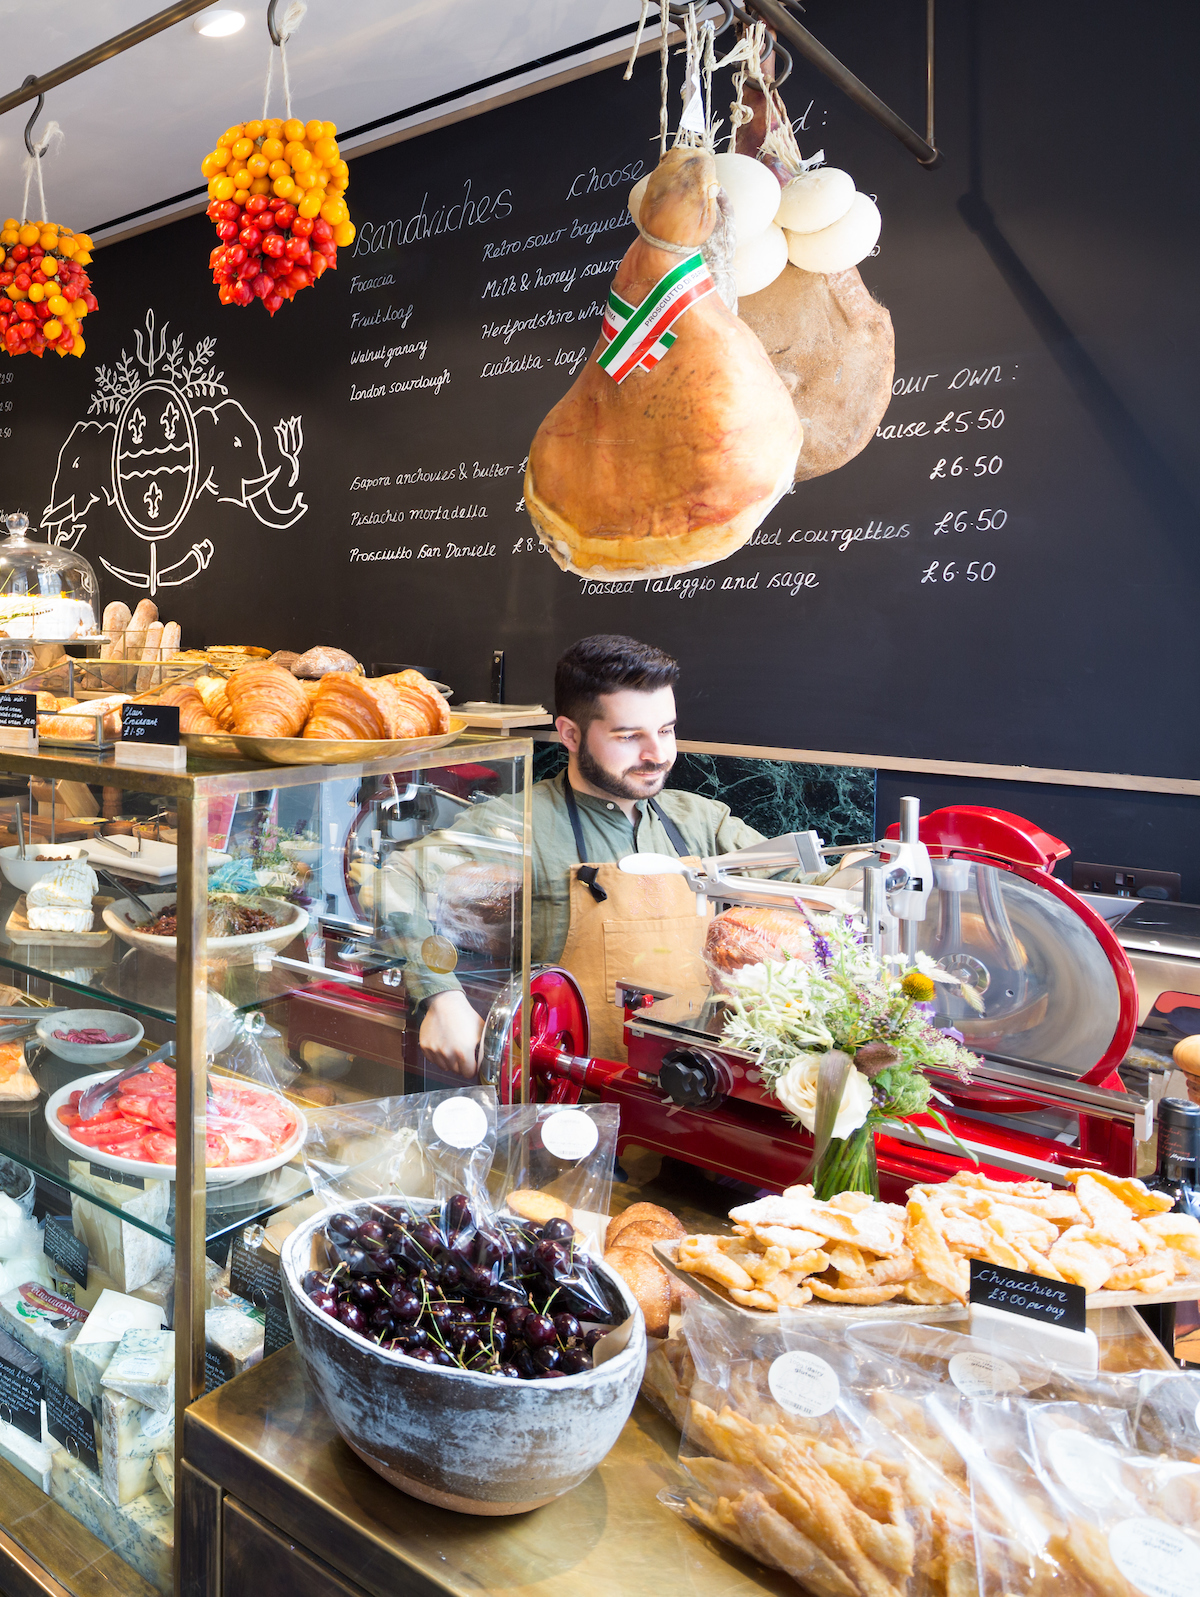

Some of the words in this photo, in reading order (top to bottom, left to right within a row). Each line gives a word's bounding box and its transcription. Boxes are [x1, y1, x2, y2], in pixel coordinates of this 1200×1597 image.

[566, 159, 647, 201] Choose
[351, 178, 514, 258] Sandwiches
[482, 239, 522, 263] Retro
[523, 227, 568, 251] sour
[569, 208, 636, 245] baguett
[350, 272, 398, 294] Focaccia
[481, 275, 517, 300] Milk
[519, 272, 530, 292] &
[534, 266, 578, 293] honey
[350, 307, 383, 330] Fruit
[383, 303, 415, 330] loaf
[481, 308, 576, 345] Hertfordshire
[576, 299, 607, 322] whi
[644, 283, 685, 328] PROSCIUTTO
[350, 344, 386, 366] Walnut
[384, 338, 429, 368] granary
[350, 382, 387, 402] London
[388, 368, 452, 396] sourdough
[890, 373, 938, 398] our
[395, 467, 456, 486] anchovies
[458, 461, 469, 480] &
[471, 460, 515, 480] butter
[350, 508, 406, 527] Pistachio
[409, 503, 489, 521] mortadella
[349, 546, 413, 562] Prosciutto
[416, 542, 442, 560] San
[444, 540, 497, 560] Daniele
[578, 577, 636, 596] Toasted
[643, 574, 717, 600] Taleggio
[720, 574, 760, 592] and
[766, 570, 821, 597] sage
[973, 1269, 1069, 1302] Chiacchiere
[987, 1287, 1027, 1306] £3.00
[1026, 1300, 1045, 1310] per
[1045, 1303, 1067, 1320] bag
